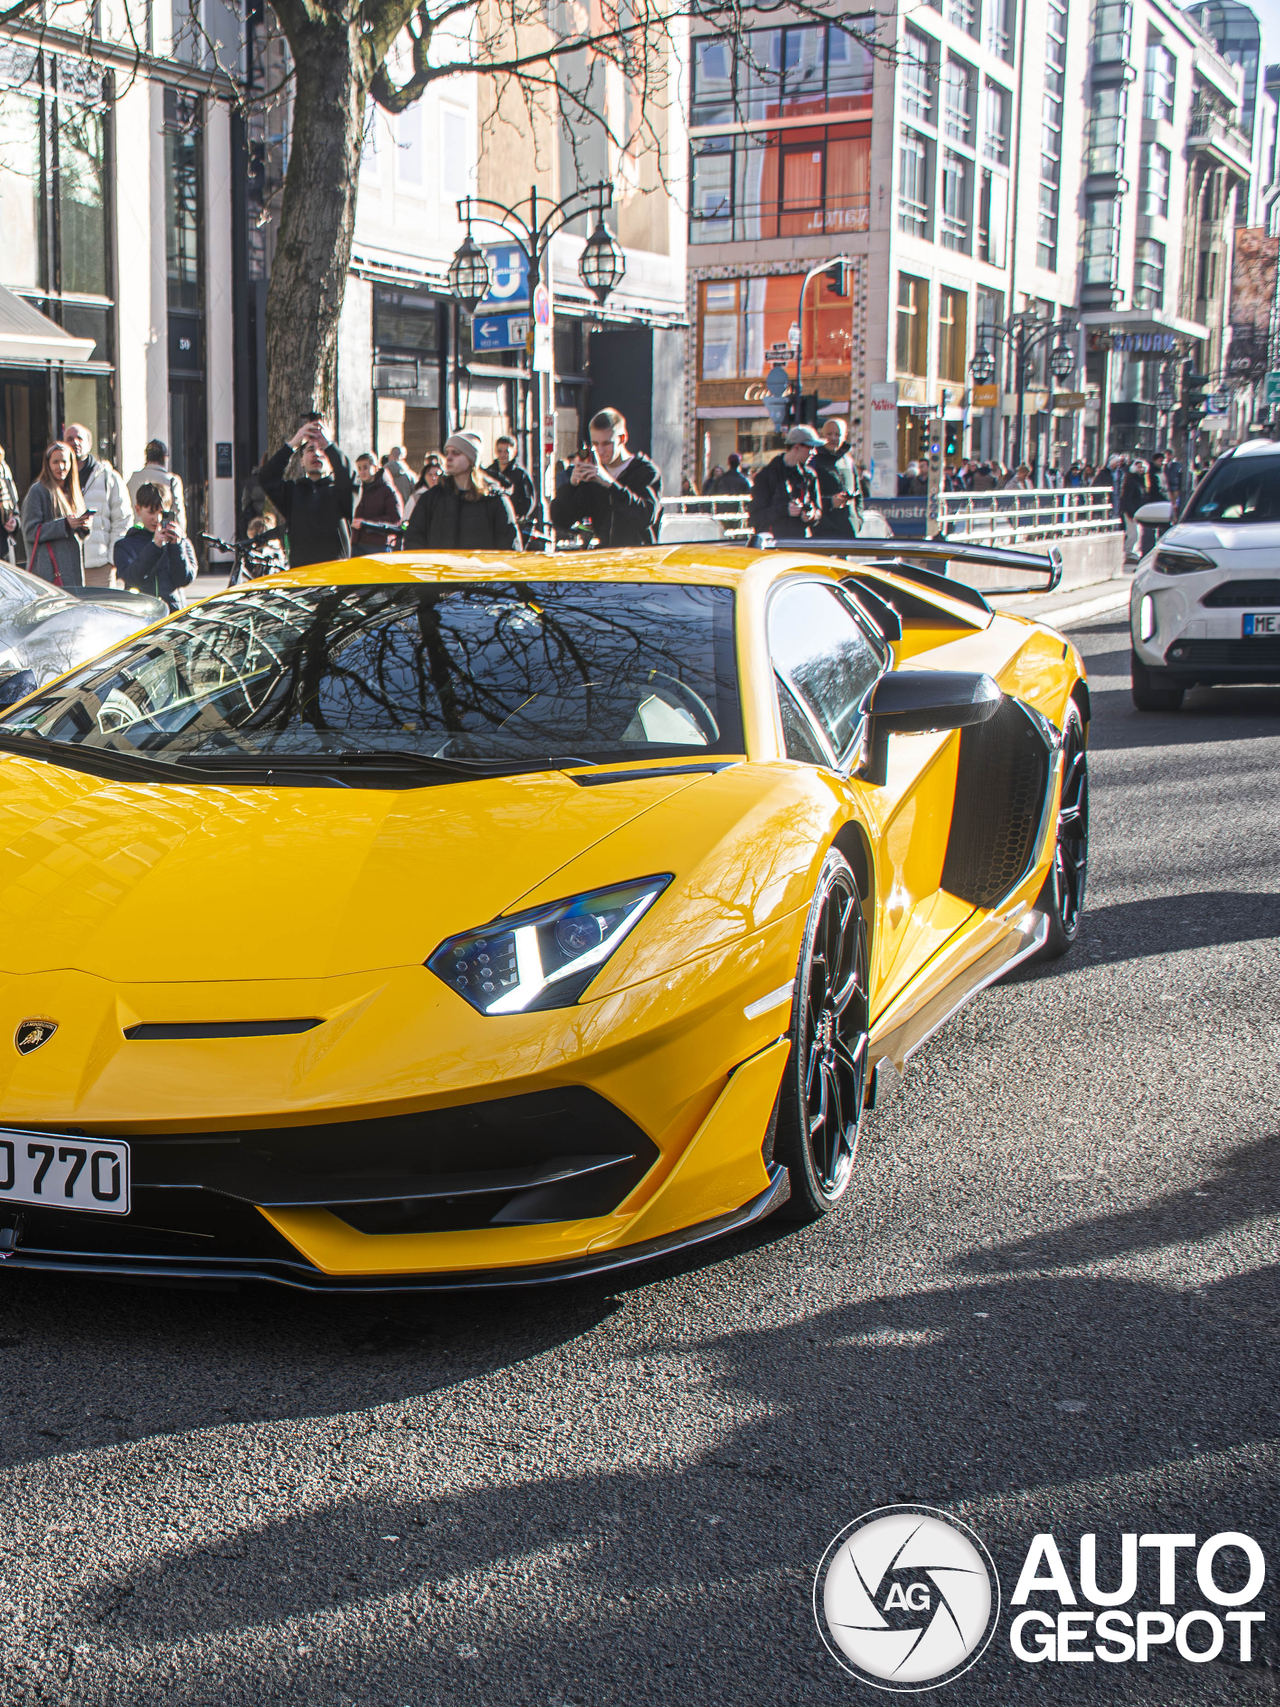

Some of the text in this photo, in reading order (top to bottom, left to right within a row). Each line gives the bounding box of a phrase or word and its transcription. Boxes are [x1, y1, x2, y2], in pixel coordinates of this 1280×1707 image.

[488, 252, 520, 298] U
[1113, 334, 1174, 352] SATURN
[1255, 617, 1276, 632] ME
